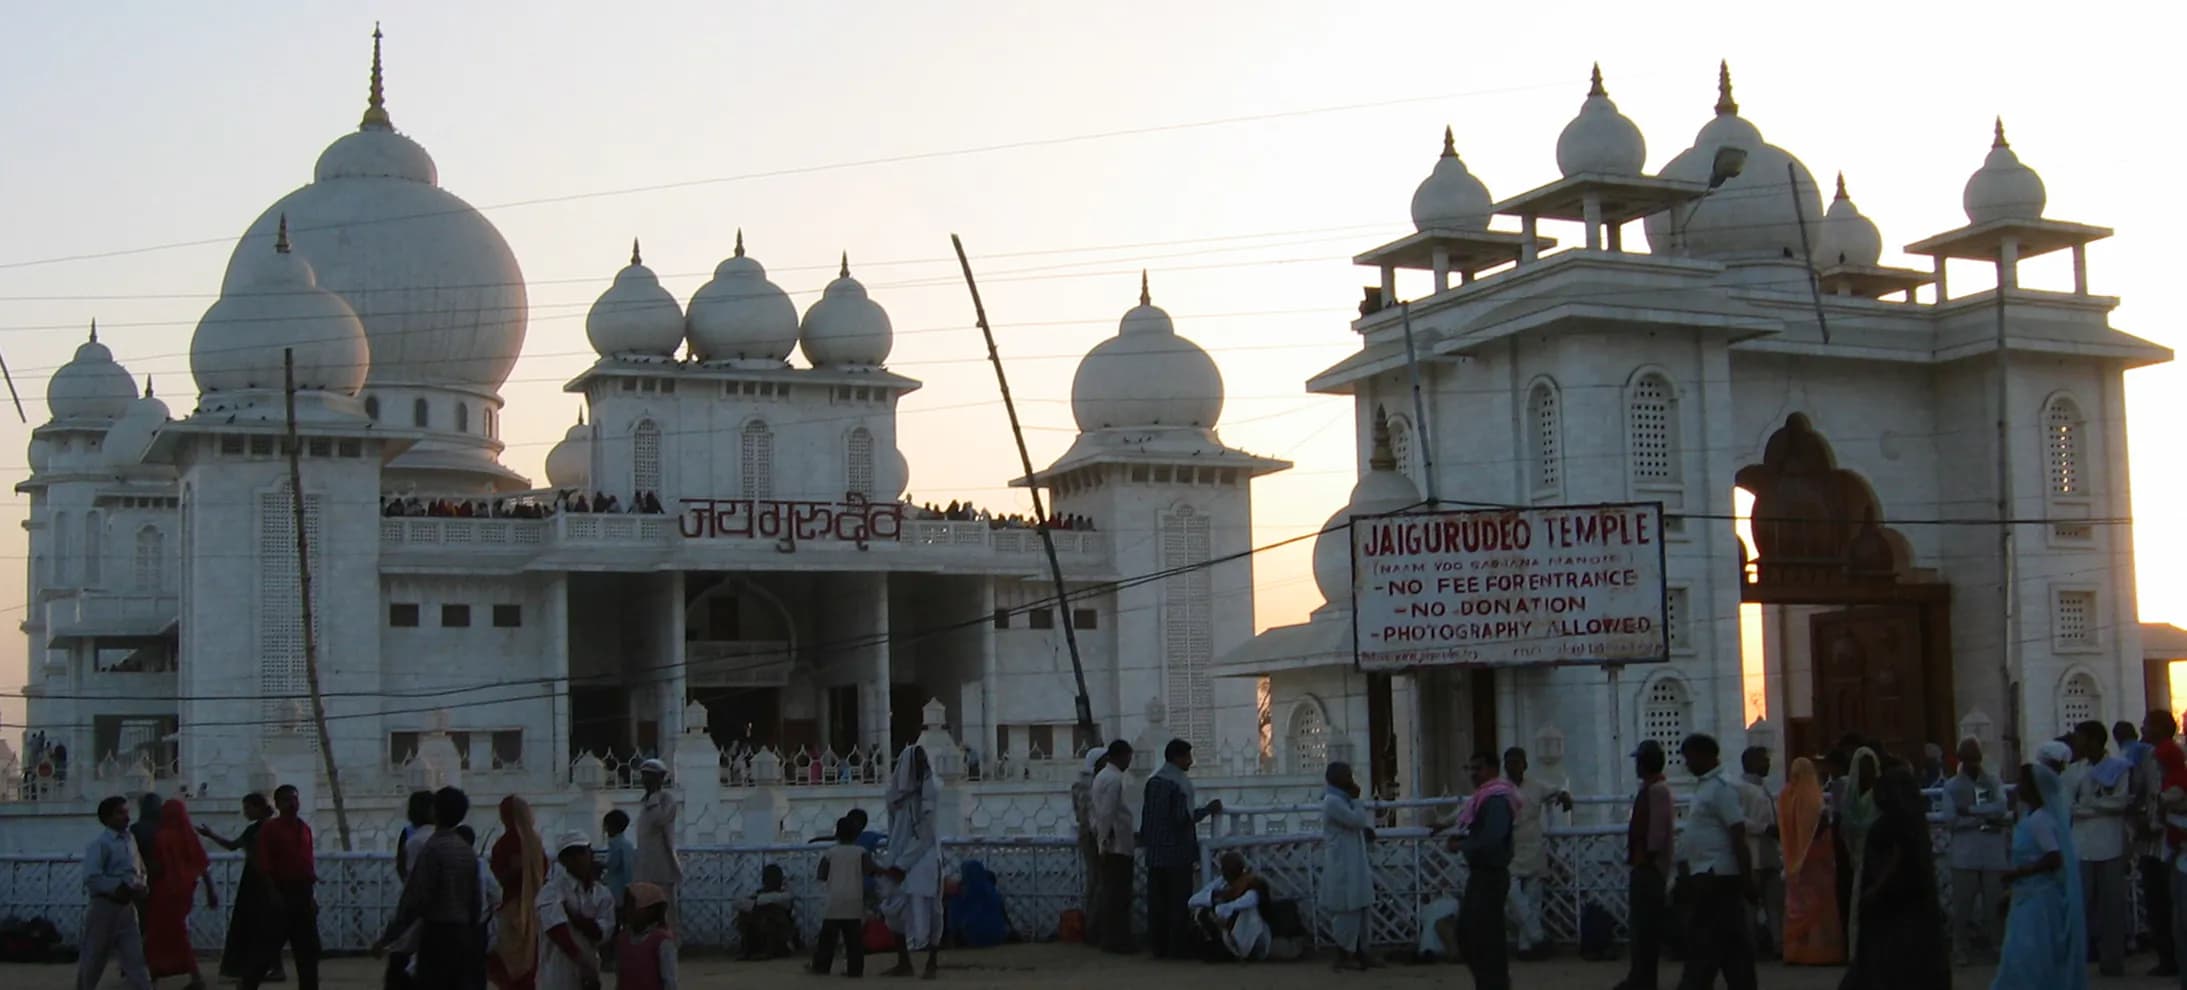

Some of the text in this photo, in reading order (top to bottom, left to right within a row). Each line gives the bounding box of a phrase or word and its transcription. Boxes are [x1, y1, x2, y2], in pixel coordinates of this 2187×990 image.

[1364, 512, 1650, 556] JAIGURUDEO TEMPLE
[1438, 576, 1480, 594] FEE
[1486, 574, 1525, 592] FOR
[1529, 569, 1637, 588] ENTRANCE
[1460, 596, 1586, 616] DONATION
[1548, 616, 1651, 637] ALLOWED
